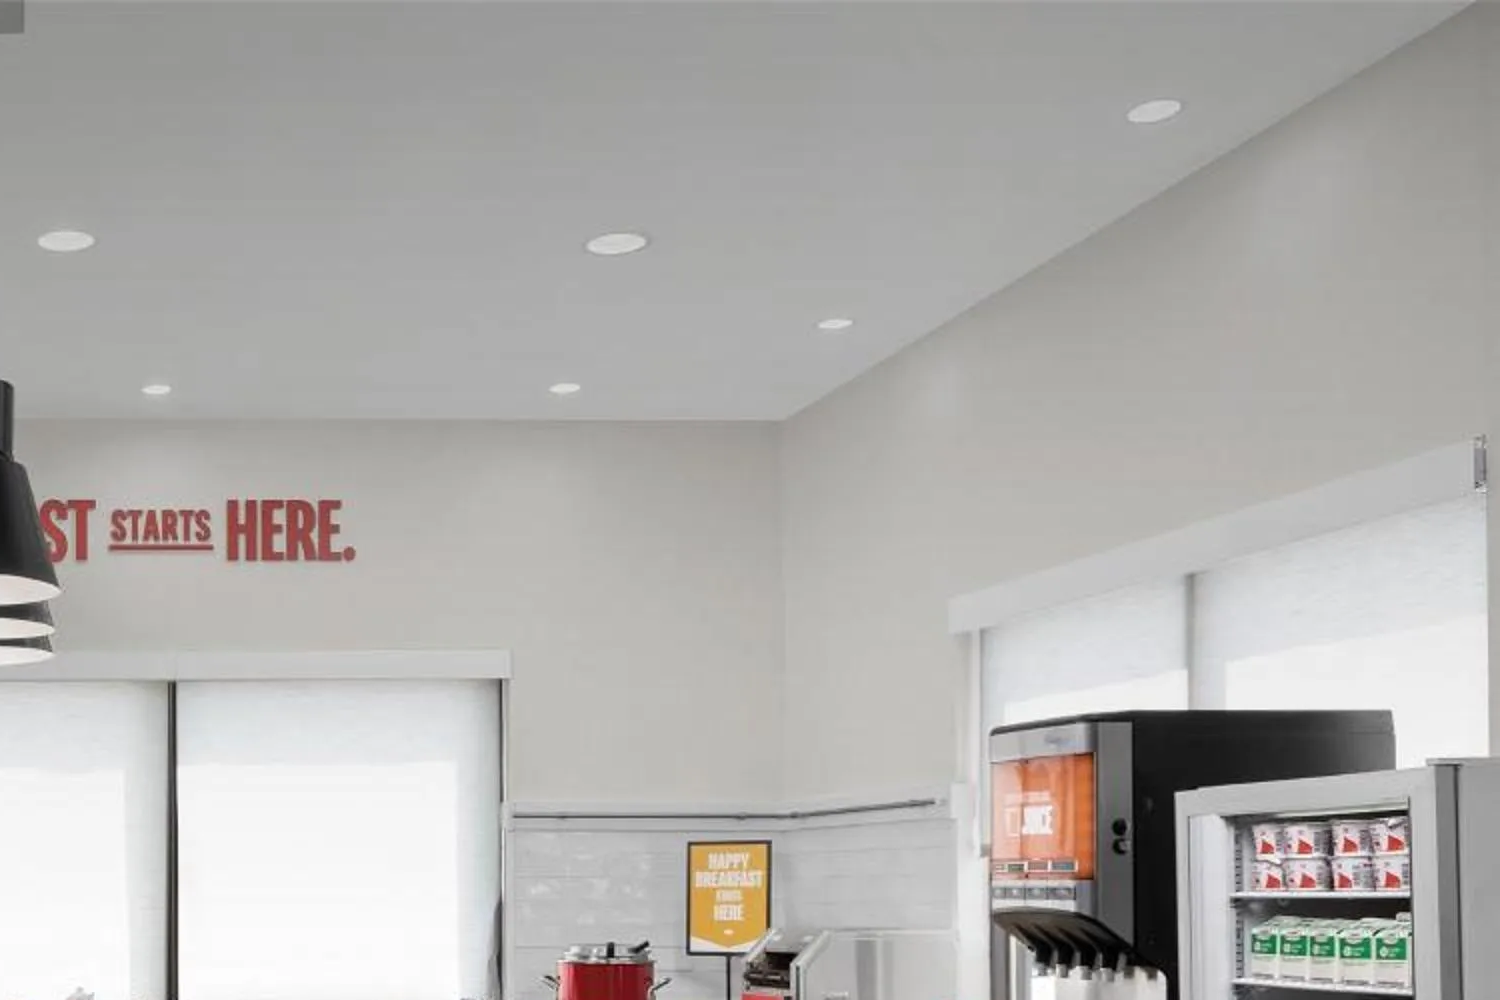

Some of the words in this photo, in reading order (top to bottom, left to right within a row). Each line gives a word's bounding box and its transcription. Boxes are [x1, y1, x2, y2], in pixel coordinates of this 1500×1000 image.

[110, 508, 212, 542] STARTS
[226, 499, 356, 562] HERE.
[707, 852, 750, 870] HAPPY
